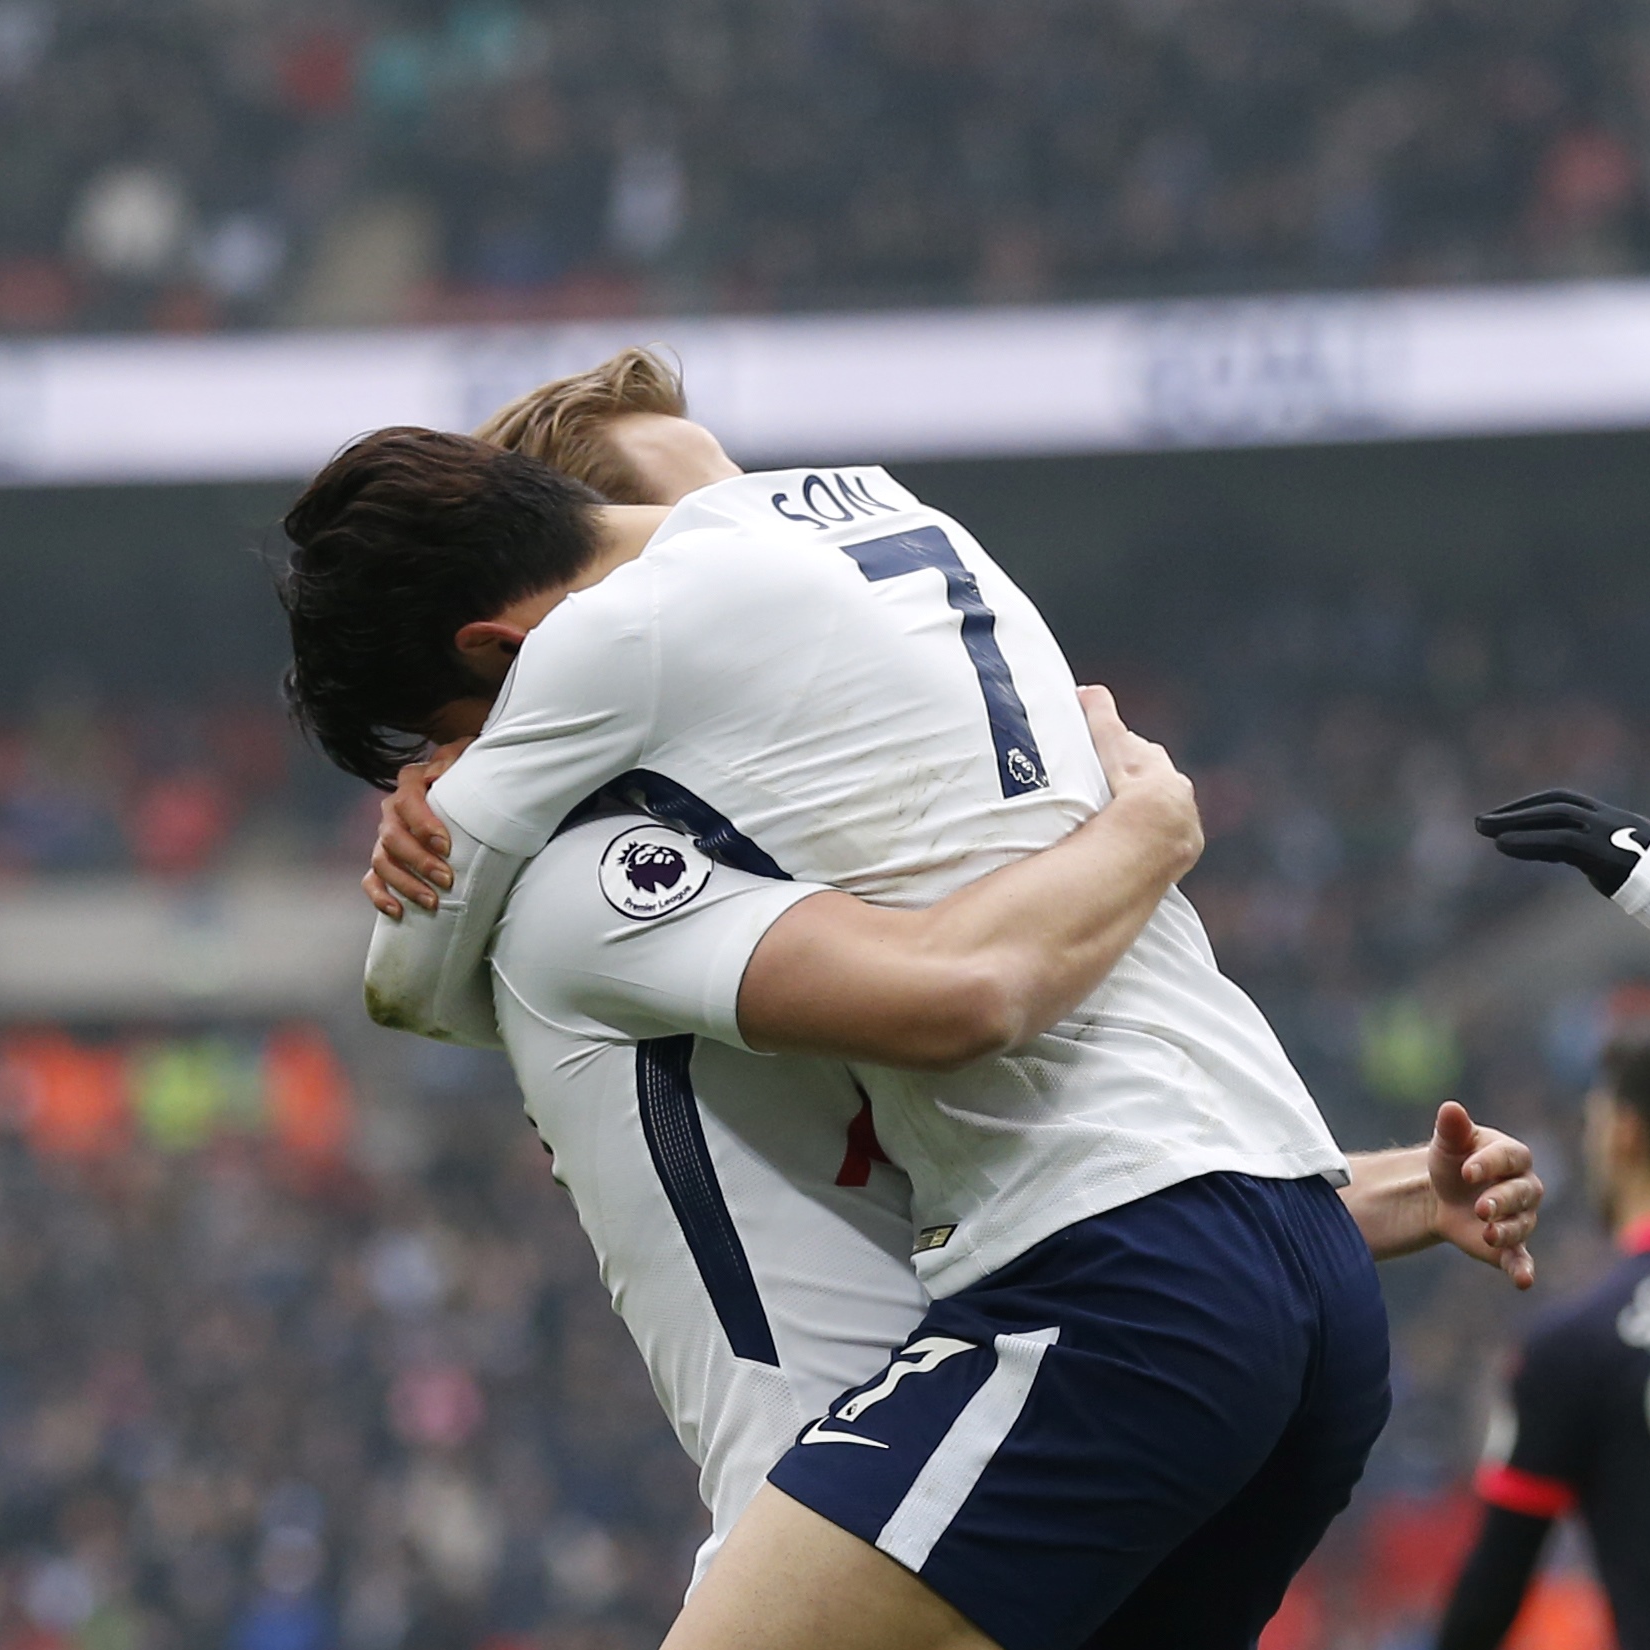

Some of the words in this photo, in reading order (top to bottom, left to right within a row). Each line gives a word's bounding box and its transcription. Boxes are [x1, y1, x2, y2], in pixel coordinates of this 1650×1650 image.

[771, 473, 902, 530] SON
[838, 525, 1050, 800] 7
[659, 885, 692, 908] League
[835, 1337, 978, 1422] 7
